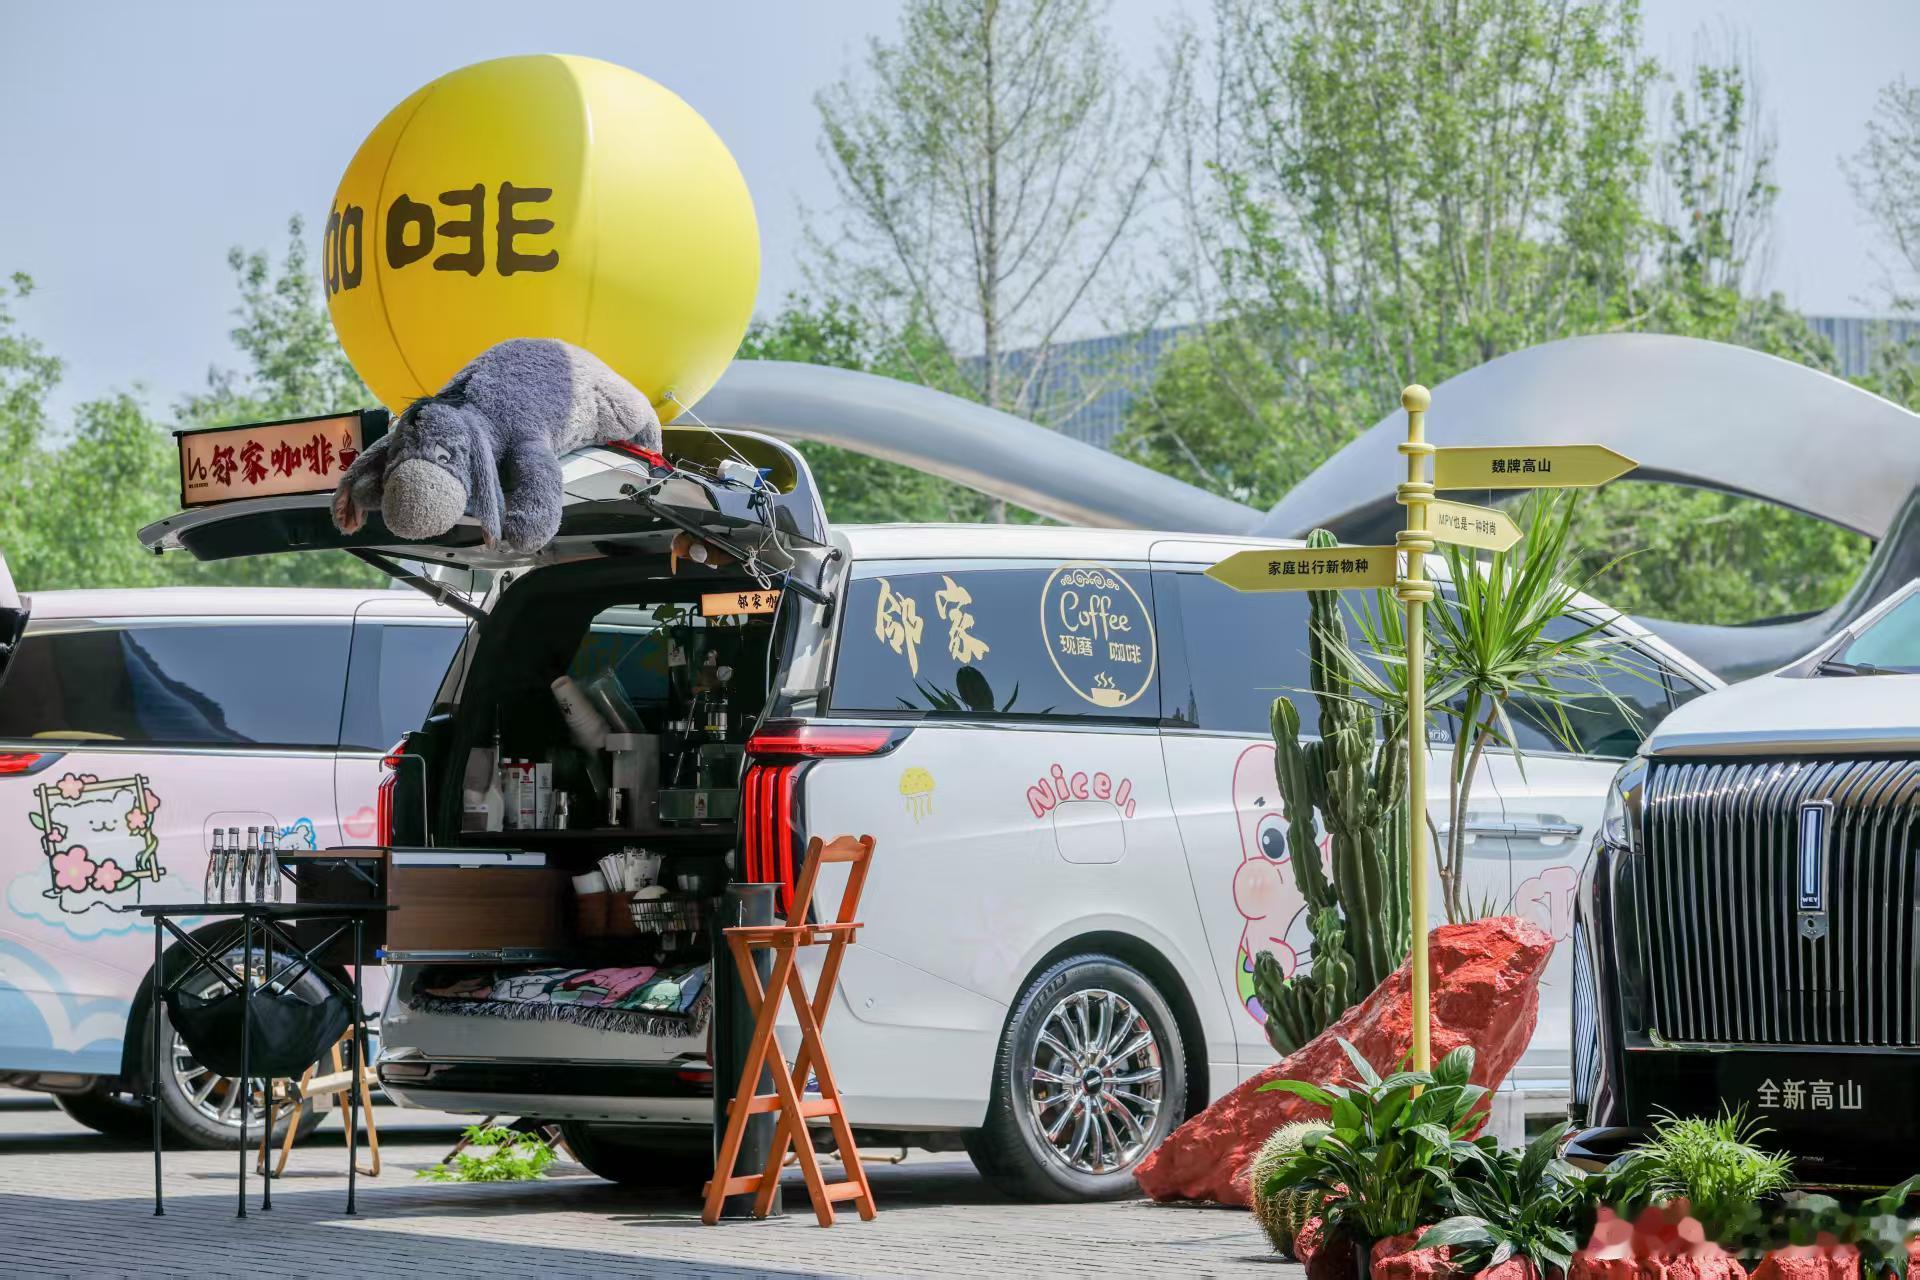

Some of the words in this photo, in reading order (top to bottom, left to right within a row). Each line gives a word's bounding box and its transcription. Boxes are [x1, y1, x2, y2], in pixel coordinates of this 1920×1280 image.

[208, 433, 336, 487] 邻家咖啡
[1491, 458, 1551, 473] 魏牌高山
[1439, 513, 1496, 536] MPV也是一种时尚
[1268, 558, 1368, 575] 家庭出行新物种
[1060, 590, 1132, 640] Coffee
[1059, 635, 1093, 657] 现磨
[1109, 641, 1142, 664] 咖啡
[1027, 764, 1136, 819] Nice!
[1756, 1078, 1862, 1111] 全新高山
